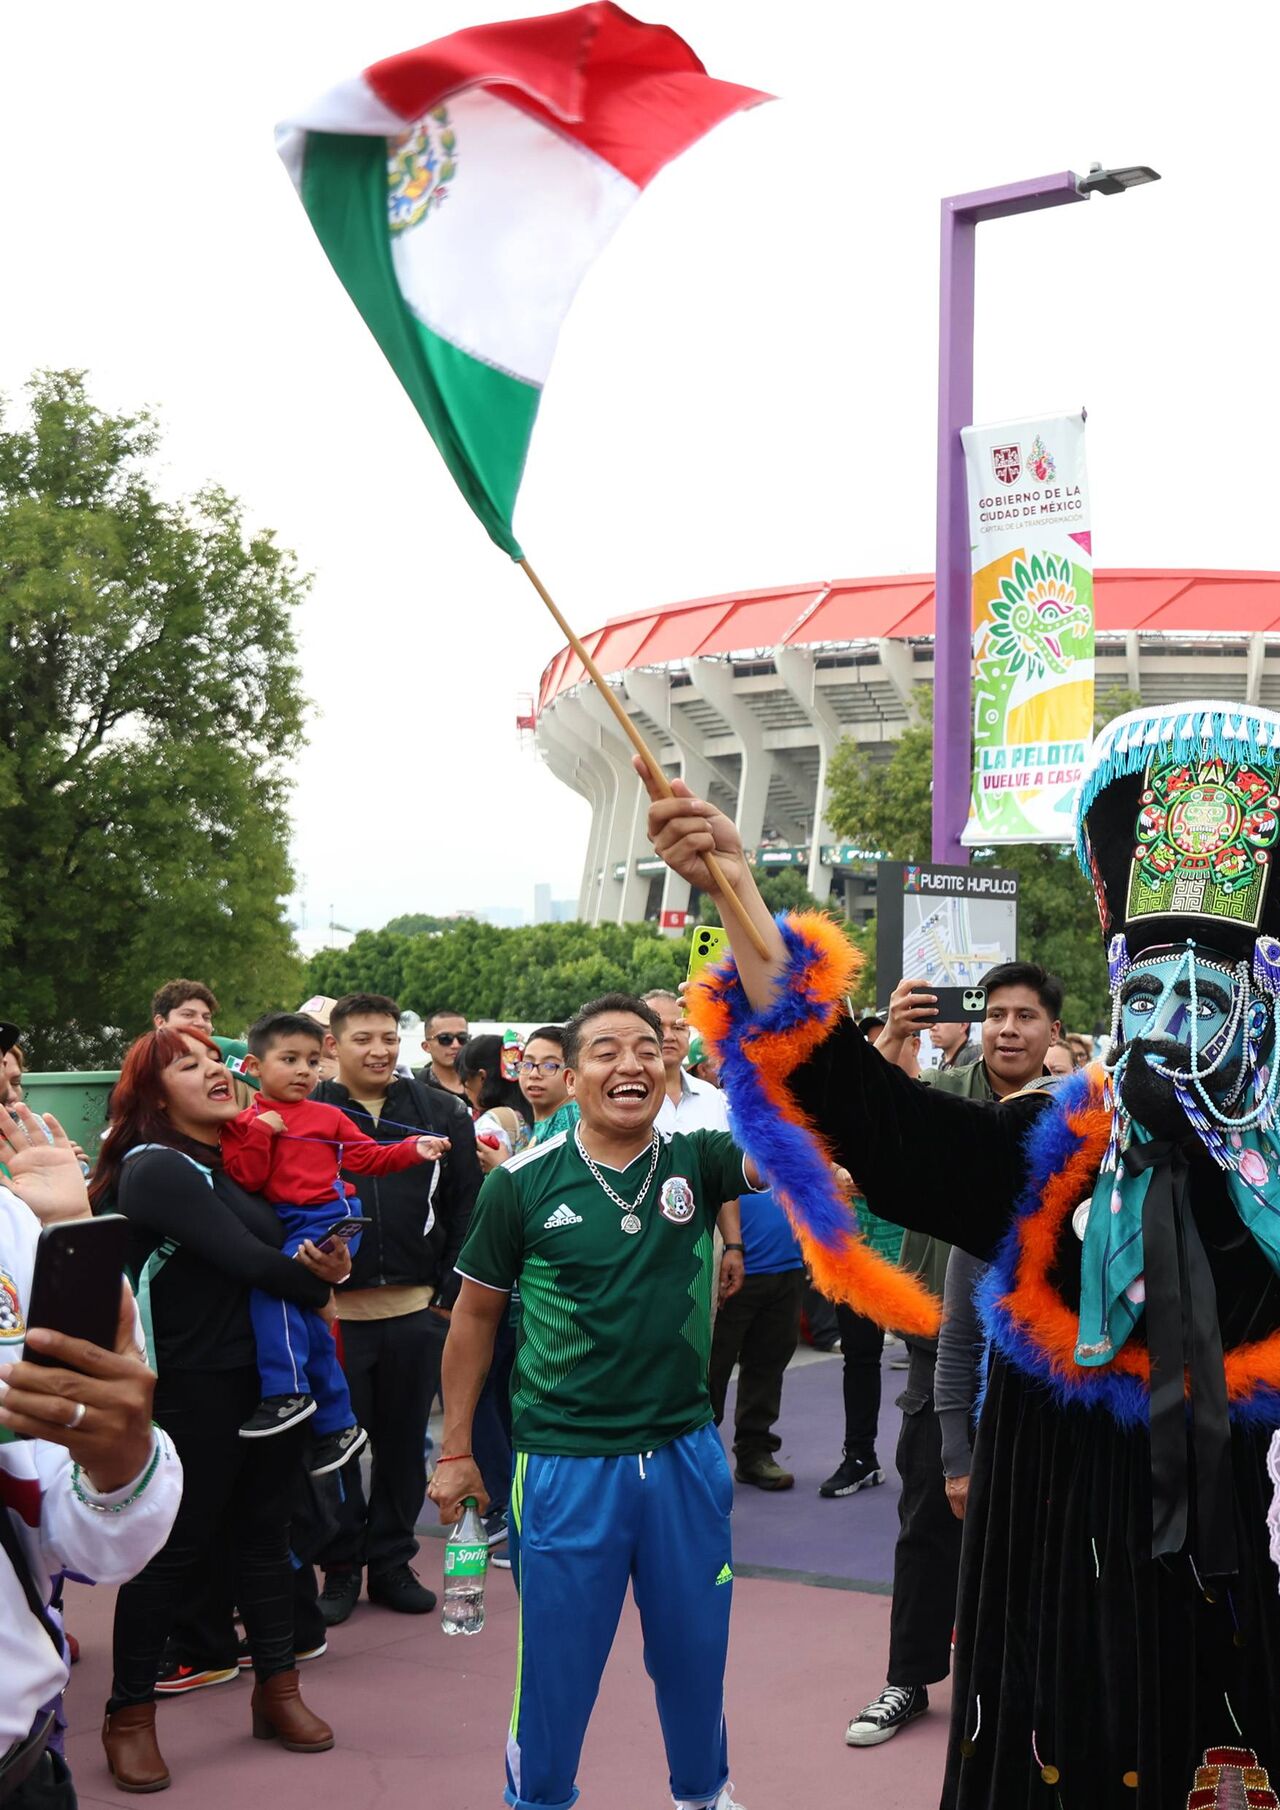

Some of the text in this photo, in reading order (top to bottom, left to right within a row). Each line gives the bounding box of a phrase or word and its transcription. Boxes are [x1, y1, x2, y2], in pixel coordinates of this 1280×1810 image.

[979, 485, 1081, 509] GOBIERNO DE LA
[979, 500, 1082, 522] CIUDAD DE MÉXICO
[983, 743, 1085, 770] LA PELOTA
[983, 769, 1081, 789] VUELVE A CASA
[920, 873, 965, 890] PUENTE
[544, 1215, 583, 1229] adidas
[456, 1548, 488, 1564] Sprite
